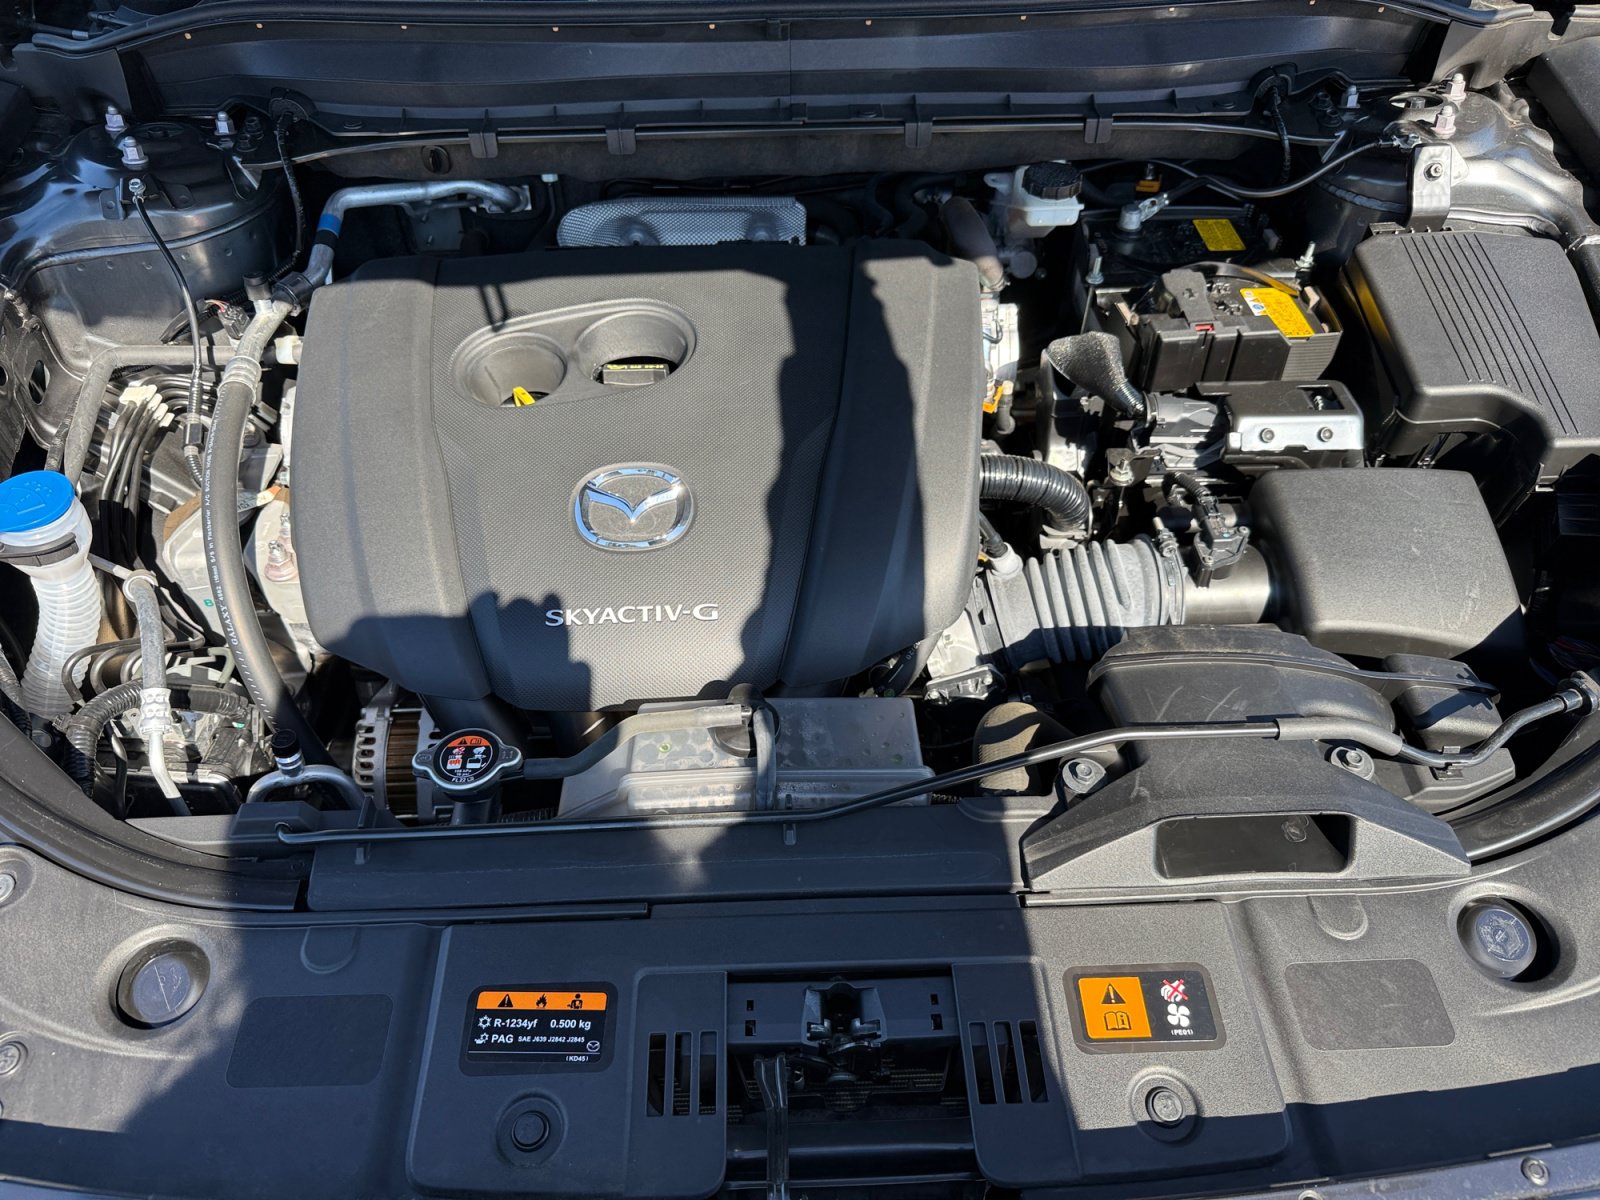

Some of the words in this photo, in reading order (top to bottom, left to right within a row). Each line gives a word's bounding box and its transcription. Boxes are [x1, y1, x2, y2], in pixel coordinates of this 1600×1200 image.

[545, 603, 719, 626] SKYACTIV-G
[220, 604, 239, 646] GALAXY
[493, 1018, 538, 1030] R-1234yf
[550, 1019, 577, 1028] 0.500
[578, 1019, 592, 1031] kg
[491, 1034, 514, 1043] PAG
[1171, 1028, 1194, 1036] (PE01)
